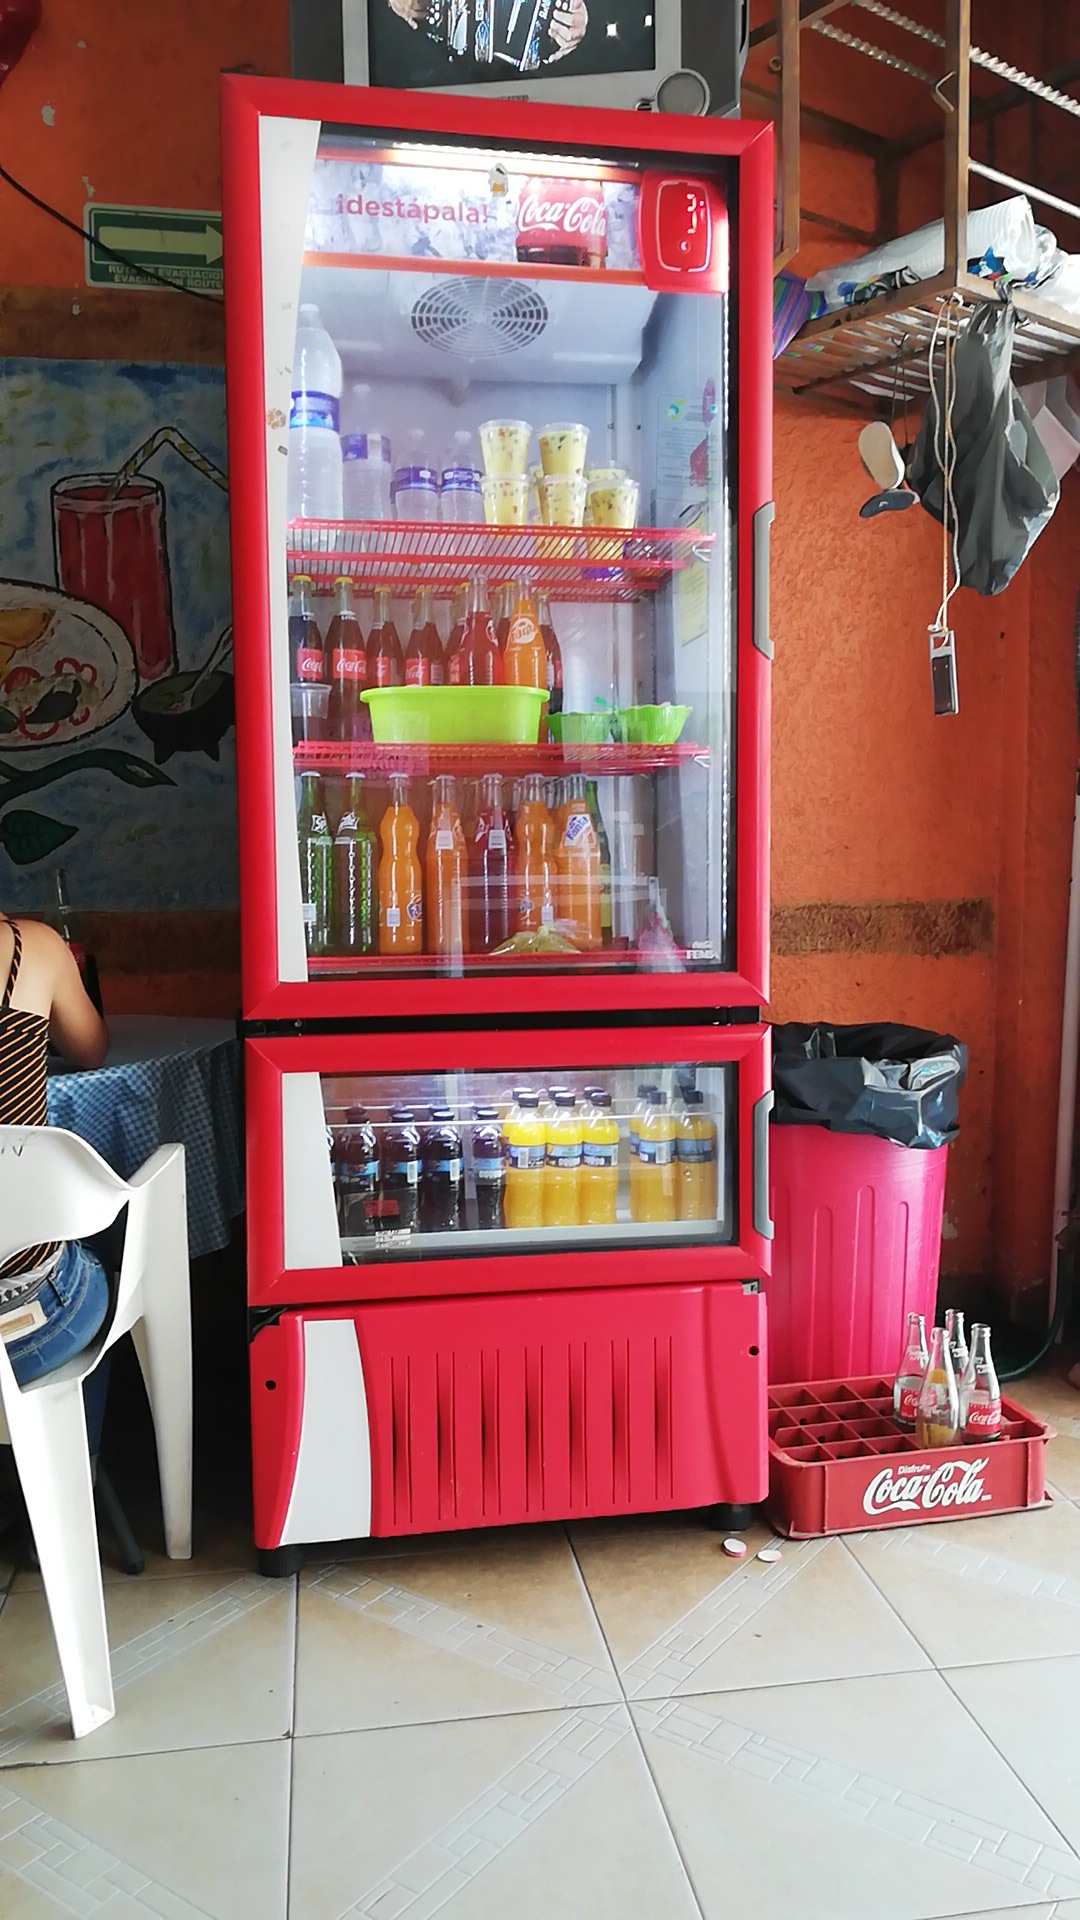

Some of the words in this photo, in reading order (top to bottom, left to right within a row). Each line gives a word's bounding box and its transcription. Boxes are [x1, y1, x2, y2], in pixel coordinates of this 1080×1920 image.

[517, 194, 607, 237] Coca-Cola
[566, 816, 589, 841] Fanta
[863, 1457, 990, 1515] Coca-Cola
